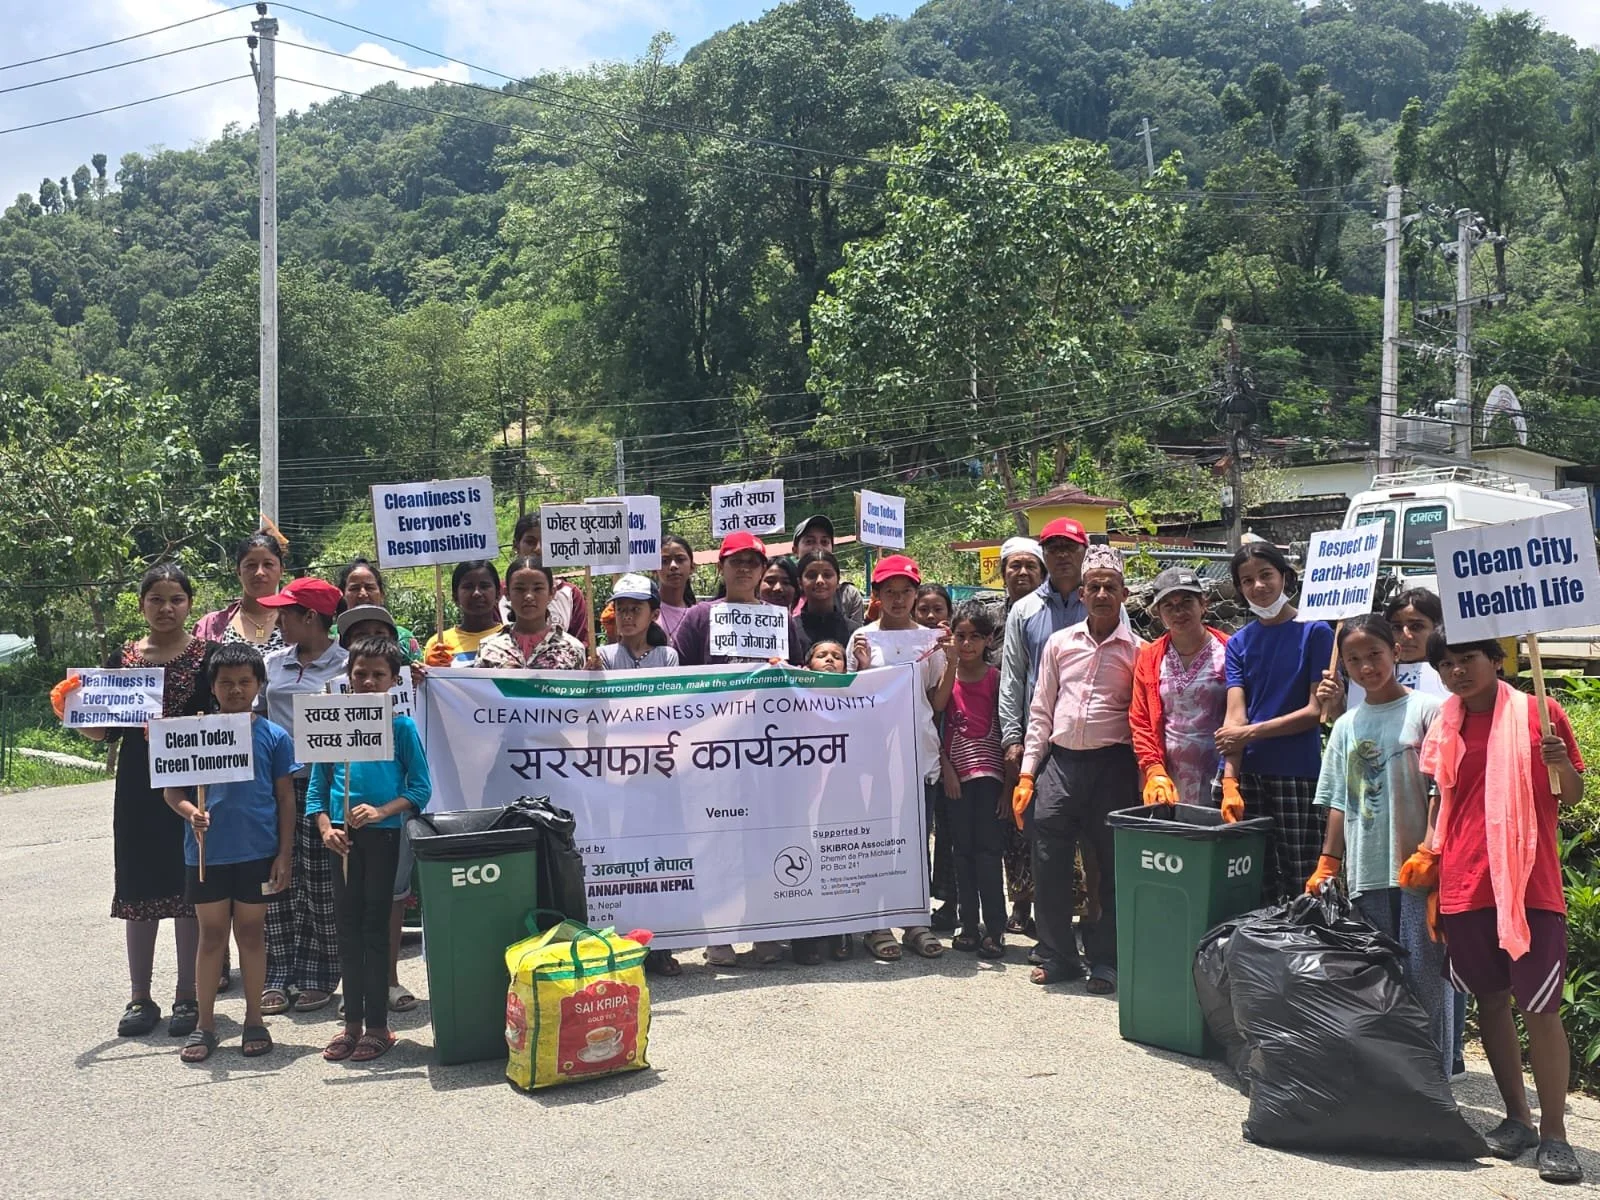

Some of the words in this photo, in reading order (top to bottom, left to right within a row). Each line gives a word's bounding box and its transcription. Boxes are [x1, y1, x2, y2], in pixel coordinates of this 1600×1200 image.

[384, 490, 466, 510] Cleanliness
[468, 487, 481, 503] is
[720, 491, 743, 508] जती
[746, 491, 776, 506] सफा
[868, 502, 880, 517] Clean
[398, 511, 472, 532] Everyone's
[546, 512, 577, 531] फोहर
[628, 512, 647, 530] day,
[720, 513, 740, 531] उती
[743, 513, 777, 528] स्वच्छ
[863, 519, 876, 534] Green
[877, 522, 903, 538] Tomorrow
[387, 533, 487, 556] Responsibility
[550, 537, 580, 560] प्रकृती
[628, 539, 657, 554] orrow
[1318, 536, 1363, 557] Respect
[1452, 546, 1524, 579] Clean
[1526, 537, 1578, 567] City,
[1307, 588, 1340, 607] worth
[1457, 582, 1538, 619] Health
[1540, 576, 1585, 607] Life
[714, 608, 753, 625] प्लाटिक
[714, 631, 738, 650] पृथ्वी
[80, 674, 142, 688] leanliness
[145, 674, 156, 688] is
[541, 684, 567, 696] Keep
[569, 687, 594, 696] your
[596, 682, 654, 693] surrounding
[686, 680, 710, 689] make
[712, 679, 727, 687] the
[729, 675, 788, 686] environment
[788, 675, 816, 685] green
[82, 692, 145, 706] Everyone's
[70, 710, 154, 724] Responsibility
[304, 707, 341, 723] स्वच्छ
[343, 706, 384, 723] समाज
[473, 708, 579, 724] CLEANING
[586, 704, 705, 724] AWARENESS
[711, 699, 756, 717] WITH
[763, 696, 876, 714] COMMUNITY
[165, 732, 198, 749] Clean
[200, 729, 237, 746] Today,
[306, 733, 342, 749] स्वच्छ
[346, 729, 383, 747] जीवन
[507, 730, 682, 780] सरसफाई
[690, 723, 850, 771] कार्यक्रम
[155, 757, 190, 774] Green
[191, 753, 249, 771] Tomorrow
[705, 807, 749, 818] Venue:
[812, 827, 858, 839] Supported
[860, 826, 870, 835] by
[594, 844, 606, 854] by
[820, 842, 860, 853] SKIBROA
[861, 838, 906, 850] Association
[591, 857, 650, 878] अन्नपूर्ण
[653, 856, 694, 872] नेपाल
[820, 852, 847, 863] Chemin
[833, 863, 846, 871] Box
[1141, 849, 1184, 874] ECO
[1227, 855, 1252, 878] ECO
[451, 863, 501, 887] ECO
[588, 881, 658, 898] ANNAPURNA
[660, 878, 695, 893] NEPAL
[773, 889, 813, 899] SKIBROA
[598, 901, 621, 911] Nepal
[575, 1001, 593, 1014] SAI
[596, 995, 629, 1011] KRIPA
